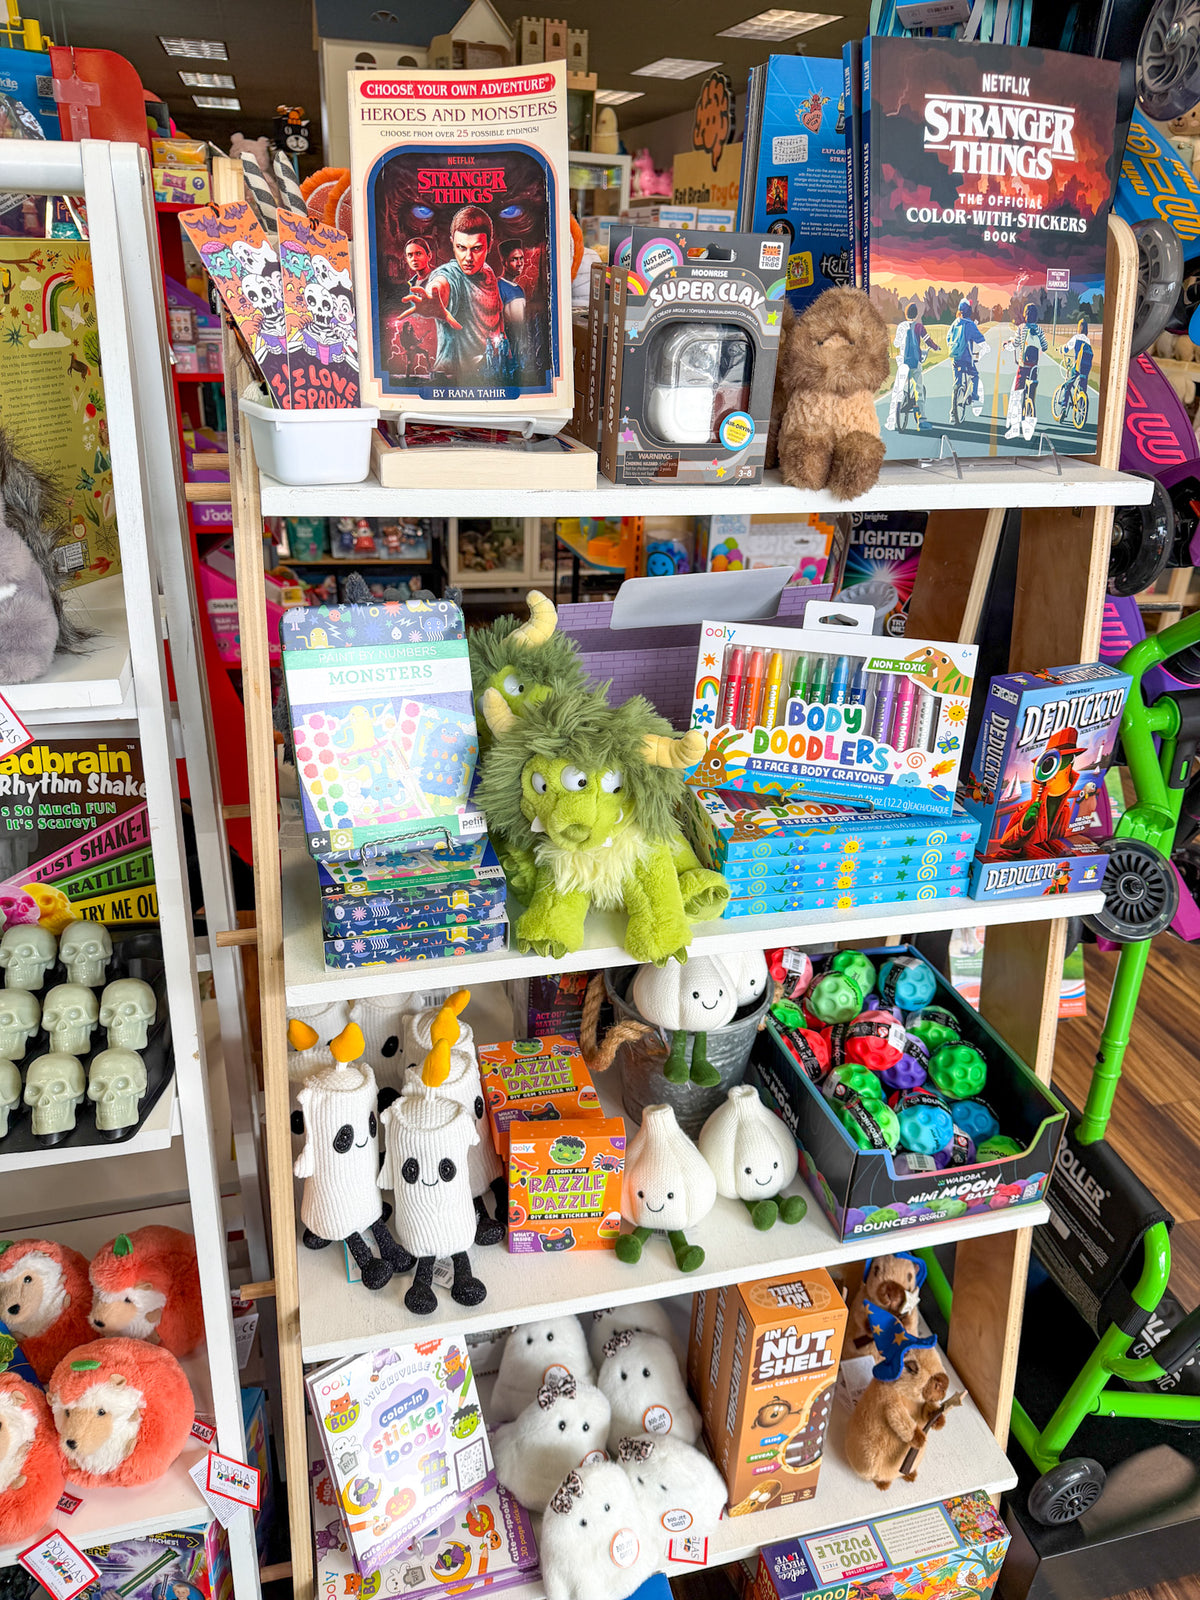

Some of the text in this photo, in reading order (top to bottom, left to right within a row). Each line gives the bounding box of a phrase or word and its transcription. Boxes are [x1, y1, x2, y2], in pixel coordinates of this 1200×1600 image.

[367, 84, 414, 95] CHOOSE
[417, 84, 447, 96] YOUR
[451, 83, 477, 96] OWN
[982, 73, 1030, 96] NETFLIX
[361, 101, 557, 121] HEROES AND MONSTERS
[457, 129, 468, 137] 25
[471, 129, 504, 137] POSSIBLE
[506, 126, 539, 136] ENDINGS!
[924, 100, 1075, 154] STRANGER
[448, 157, 475, 165] NETFLIX
[949, 140, 1053, 180] THINGS
[417, 170, 507, 190] STRANGER
[431, 188, 493, 203] THINGS
[689, 184, 709, 203] Brain
[959, 193, 1043, 209] THE OFFICIAL
[906, 207, 1086, 233] COLOR-WITH-STICKERS
[984, 230, 1016, 243] BOOK
[643, 248, 672, 267] JUST ADD
[691, 269, 728, 278] MOONRISE
[650, 281, 765, 310] SUPER CLAY
[293, 364, 358, 402] I LOVE
[433, 389, 506, 398] BY RANA TAHIR
[864, 513, 888, 522] brightz
[850, 530, 923, 547] LIGHTED
[864, 547, 905, 560] HORN
[705, 626, 736, 641] ooly
[319, 646, 437, 663] PAINT BY NUMBERS
[961, 649, 973, 658] 6+
[329, 665, 432, 685] MONSTERS
[789, 701, 862, 734] BODY
[1018, 688, 1125, 747] DEDUCKTO
[753, 726, 889, 772] DOODLERS
[983, 712, 1010, 791] DEDUCKTO
[752, 759, 763, 769] 12
[765, 761, 789, 773] FACE
[791, 764, 798, 773] &
[800, 765, 830, 779] BODY
[832, 768, 885, 785] CRAYONS
[0, 772, 82, 804] Rhythm
[14, 802, 116, 816] So Much FUN
[6, 817, 97, 830] It's Scarey!
[462, 816, 483, 829] petit
[35, 811, 150, 881] JUST SHAKE-I
[311, 837, 328, 848] 6+
[478, 867, 499, 877] petit
[985, 863, 1056, 890] DEDUCKTO
[80, 899, 132, 921] TRY ME
[501, 1058, 570, 1079] RAZZLE
[508, 1073, 571, 1091] DAZZLE
[529, 1174, 604, 1195] RAZZLE
[938, 1173, 1002, 1200] MOON
[945, 1173, 981, 1184] WABOBA
[532, 1194, 601, 1211] DAZZLE
[965, 1189, 996, 1201] BALL
[853, 1216, 917, 1234] BOUNCES
[764, 1325, 798, 1341] IN A
[761, 1328, 835, 1362] NUT
[759, 1350, 835, 1380] SHELL
[321, 1371, 352, 1396] ooly
[364, 1361, 431, 1407] STICKIVILLE
[775, 1378, 798, 1387] CRACK
[331, 1409, 357, 1431] BOO
[372, 1399, 444, 1454] sticker
[385, 1421, 441, 1466] book
[214, 1460, 256, 1484] DOUGLAS
[343, 1457, 355, 1469] RIP
[815, 1534, 872, 1559] PUZZLE
[46, 1540, 87, 1583] DOUGLAS
[841, 1548, 878, 1568] 1000
